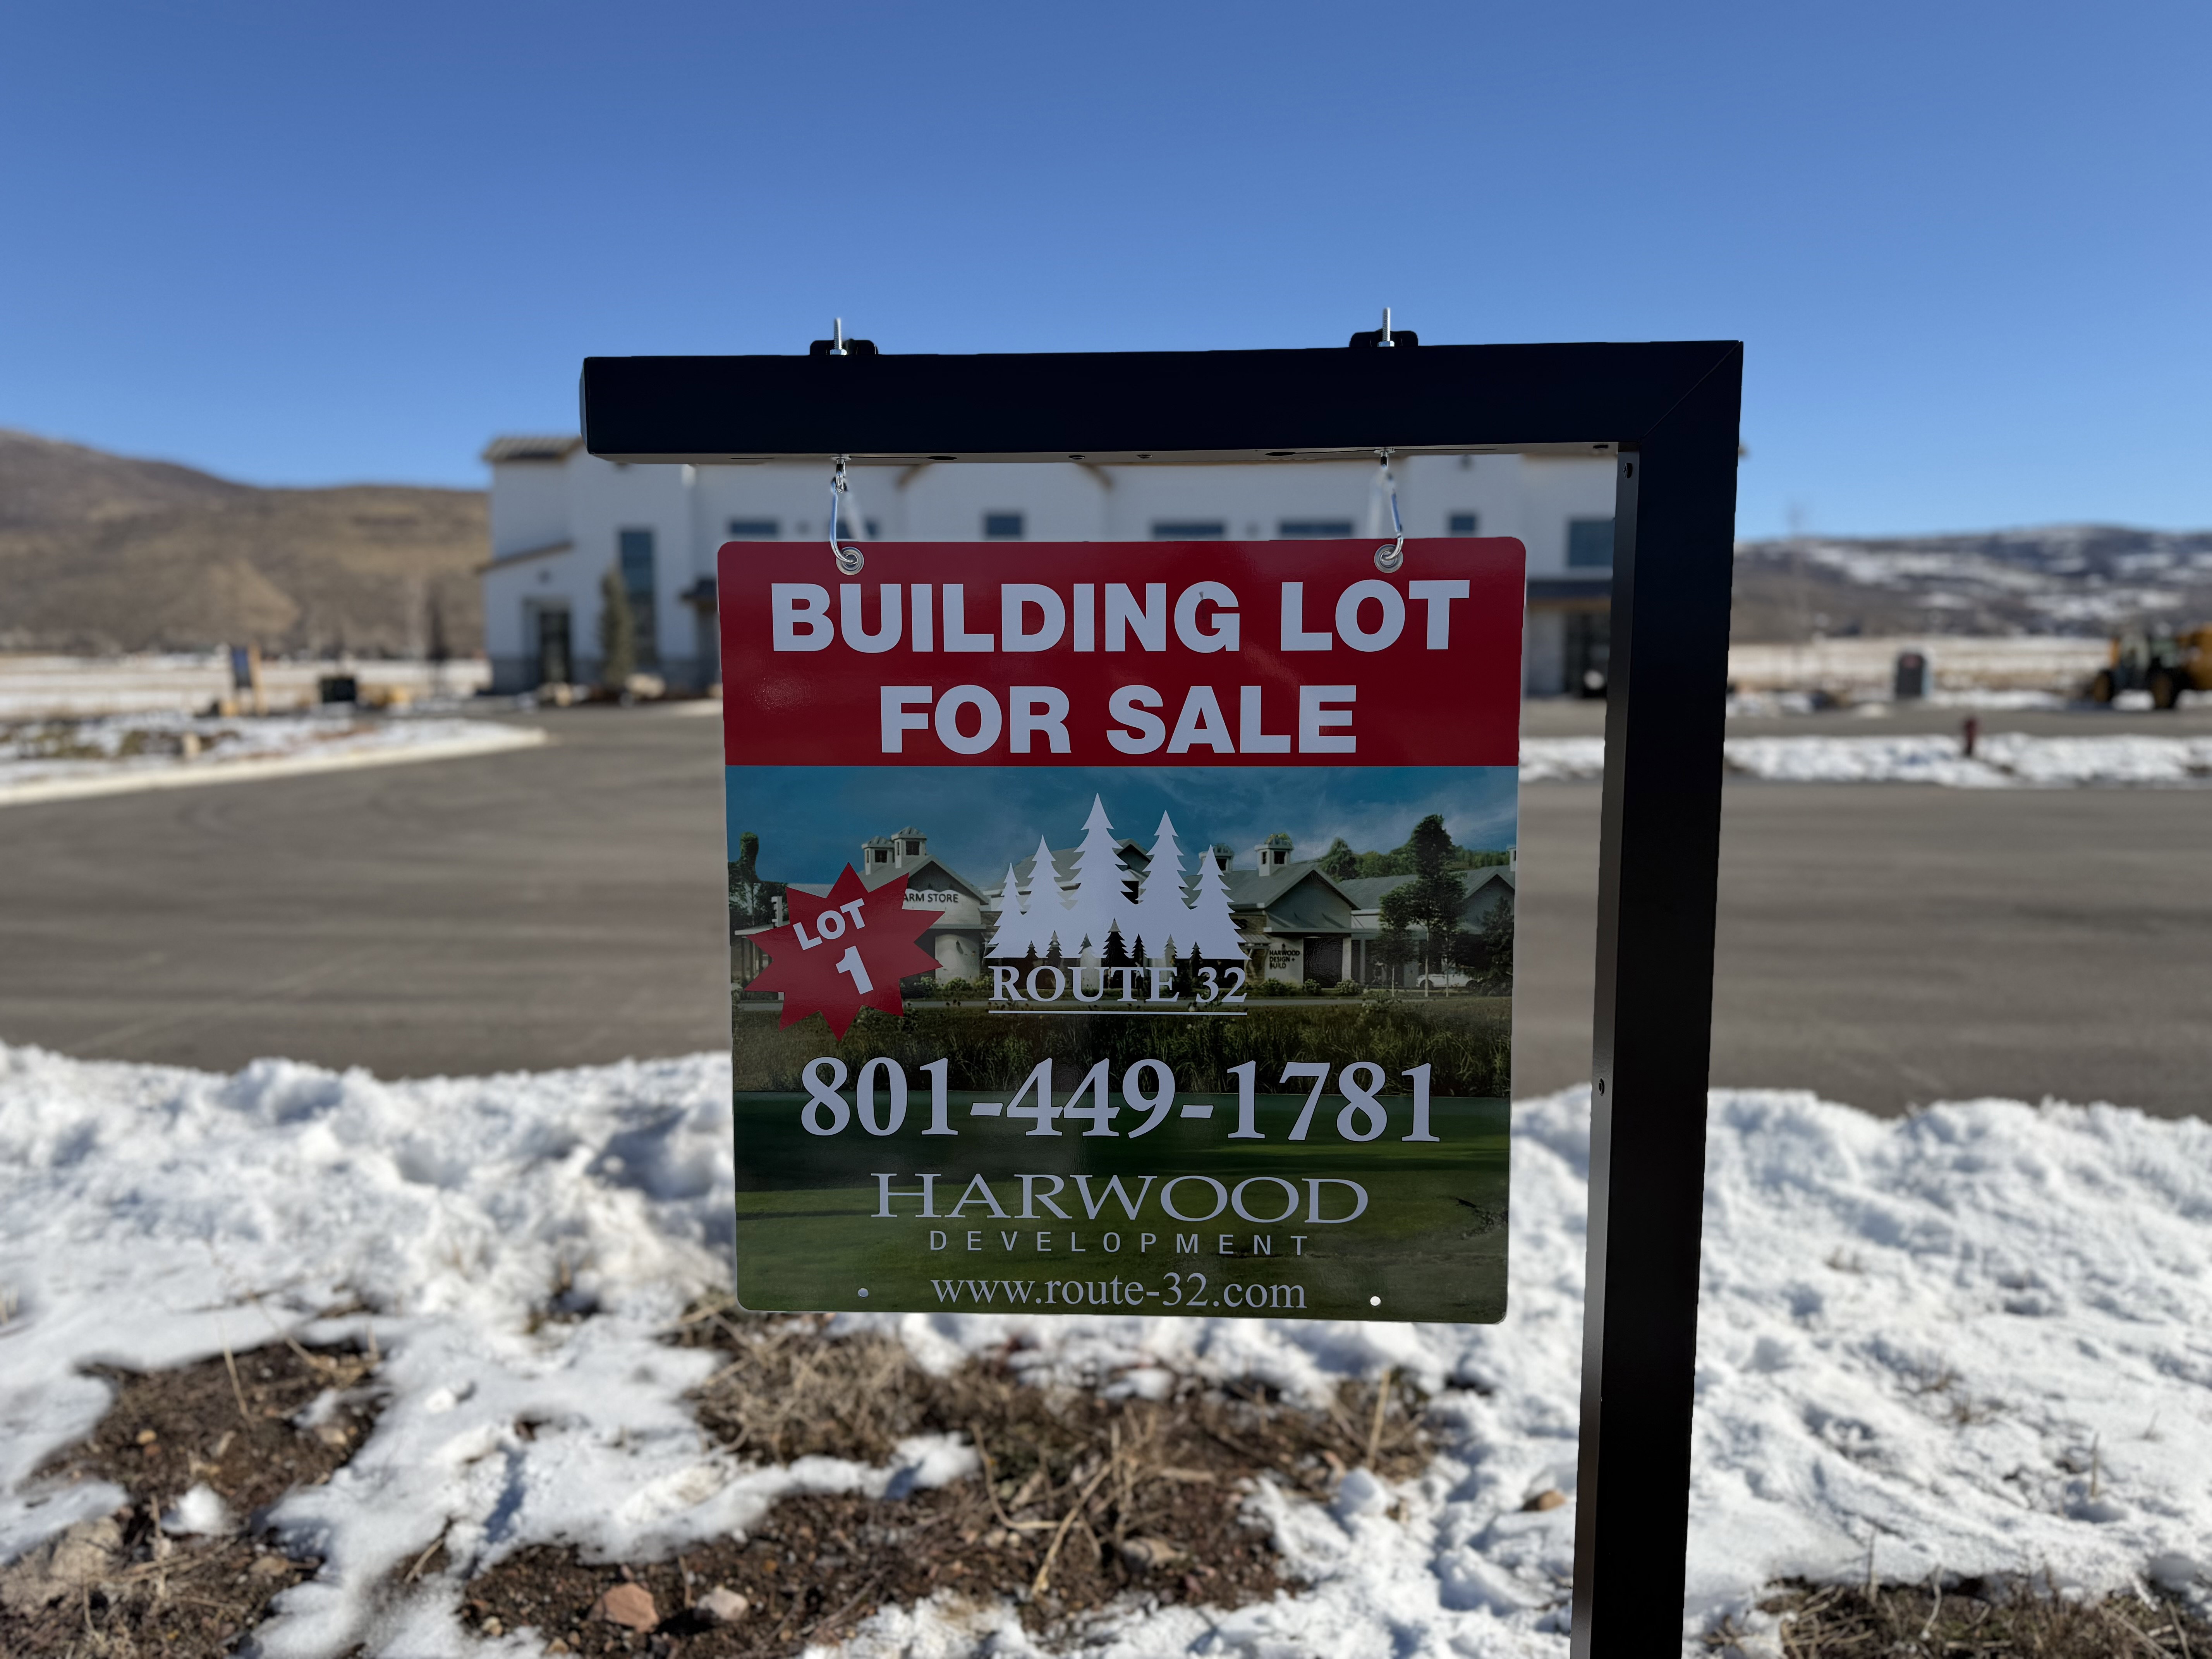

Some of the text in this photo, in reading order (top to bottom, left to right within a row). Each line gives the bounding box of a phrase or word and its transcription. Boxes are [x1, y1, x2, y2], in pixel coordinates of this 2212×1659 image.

[771, 579, 1470, 654] BUILDING LOT
[880, 684, 1357, 755] FOR SALE
[904, 893, 958, 903] ARM STORE
[792, 898, 866, 951] LOT
[835, 945, 874, 995] 1
[988, 965, 1248, 1003] ROUTE 32
[800, 1056, 1440, 1142] 801-449-1781
[870, 1173, 1369, 1224] HARWOOD
[929, 1230, 1308, 1256] DEVELOPMENT
[930, 1272, 1307, 1309] www.route-32.com
